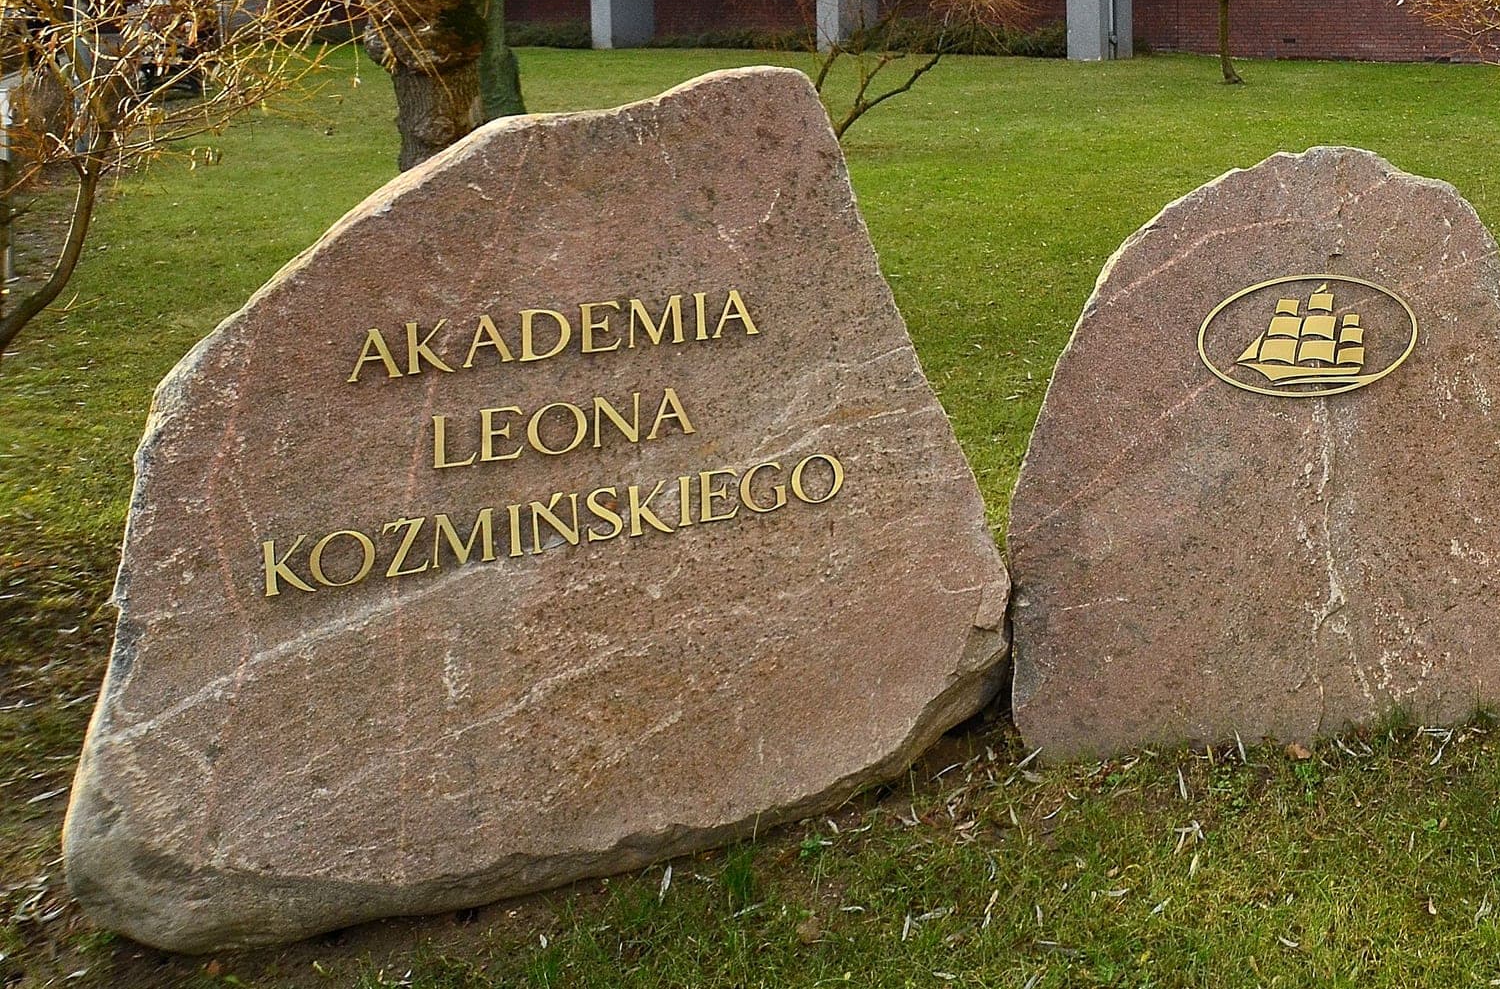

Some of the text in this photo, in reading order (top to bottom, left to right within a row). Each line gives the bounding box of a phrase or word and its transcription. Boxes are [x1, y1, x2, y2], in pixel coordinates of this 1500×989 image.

[347, 289, 760, 383] AKADEMIA
[432, 387, 696, 469] LEONA
[262, 454, 845, 598] KOŹMIŃSKIEGO
